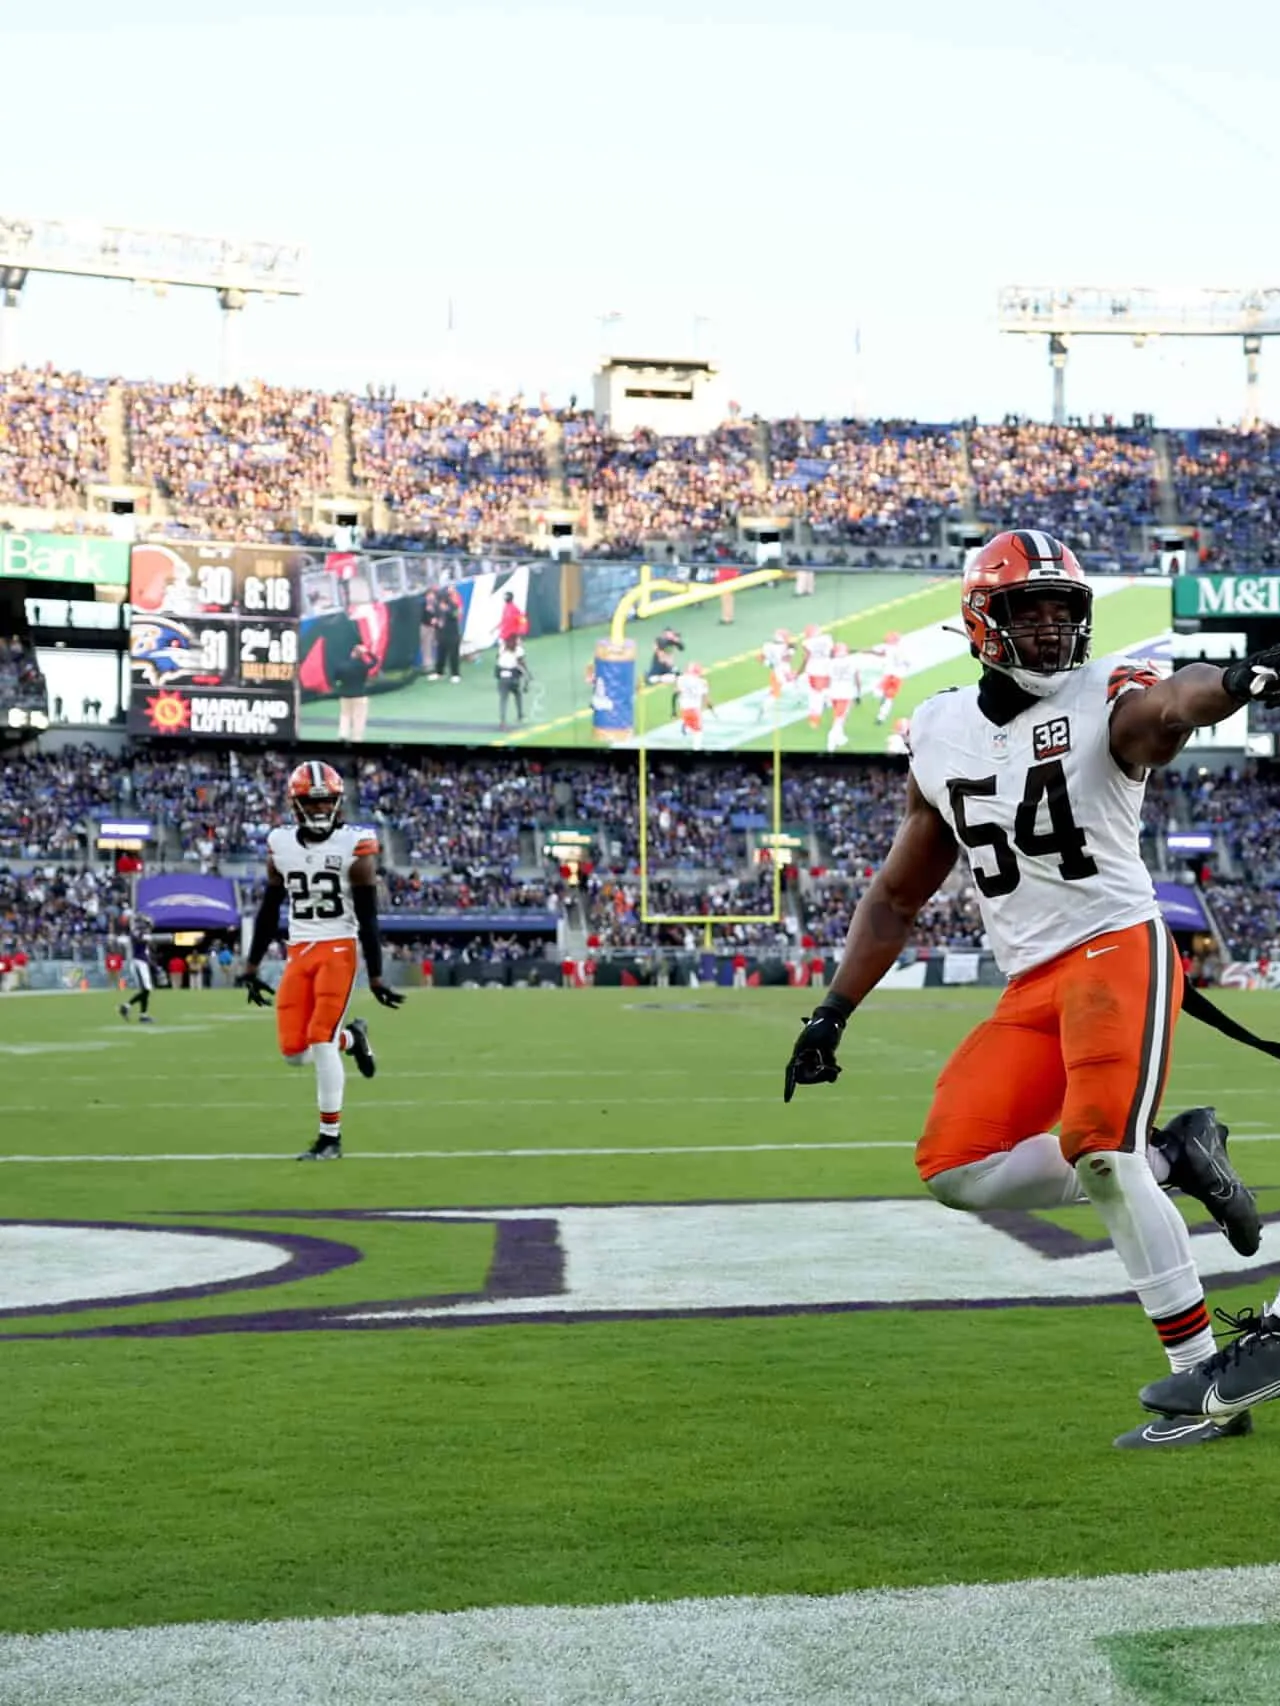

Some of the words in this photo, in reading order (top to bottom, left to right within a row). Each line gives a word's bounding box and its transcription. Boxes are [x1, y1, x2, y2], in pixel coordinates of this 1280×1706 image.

[4, 533, 106, 578] Bank
[198, 566, 233, 605] 30
[200, 629, 228, 670] 31
[190, 697, 289, 719] MARYLAND
[1035, 719, 1069, 750] 32
[945, 758, 1099, 899] 54
[286, 871, 344, 920] 23
